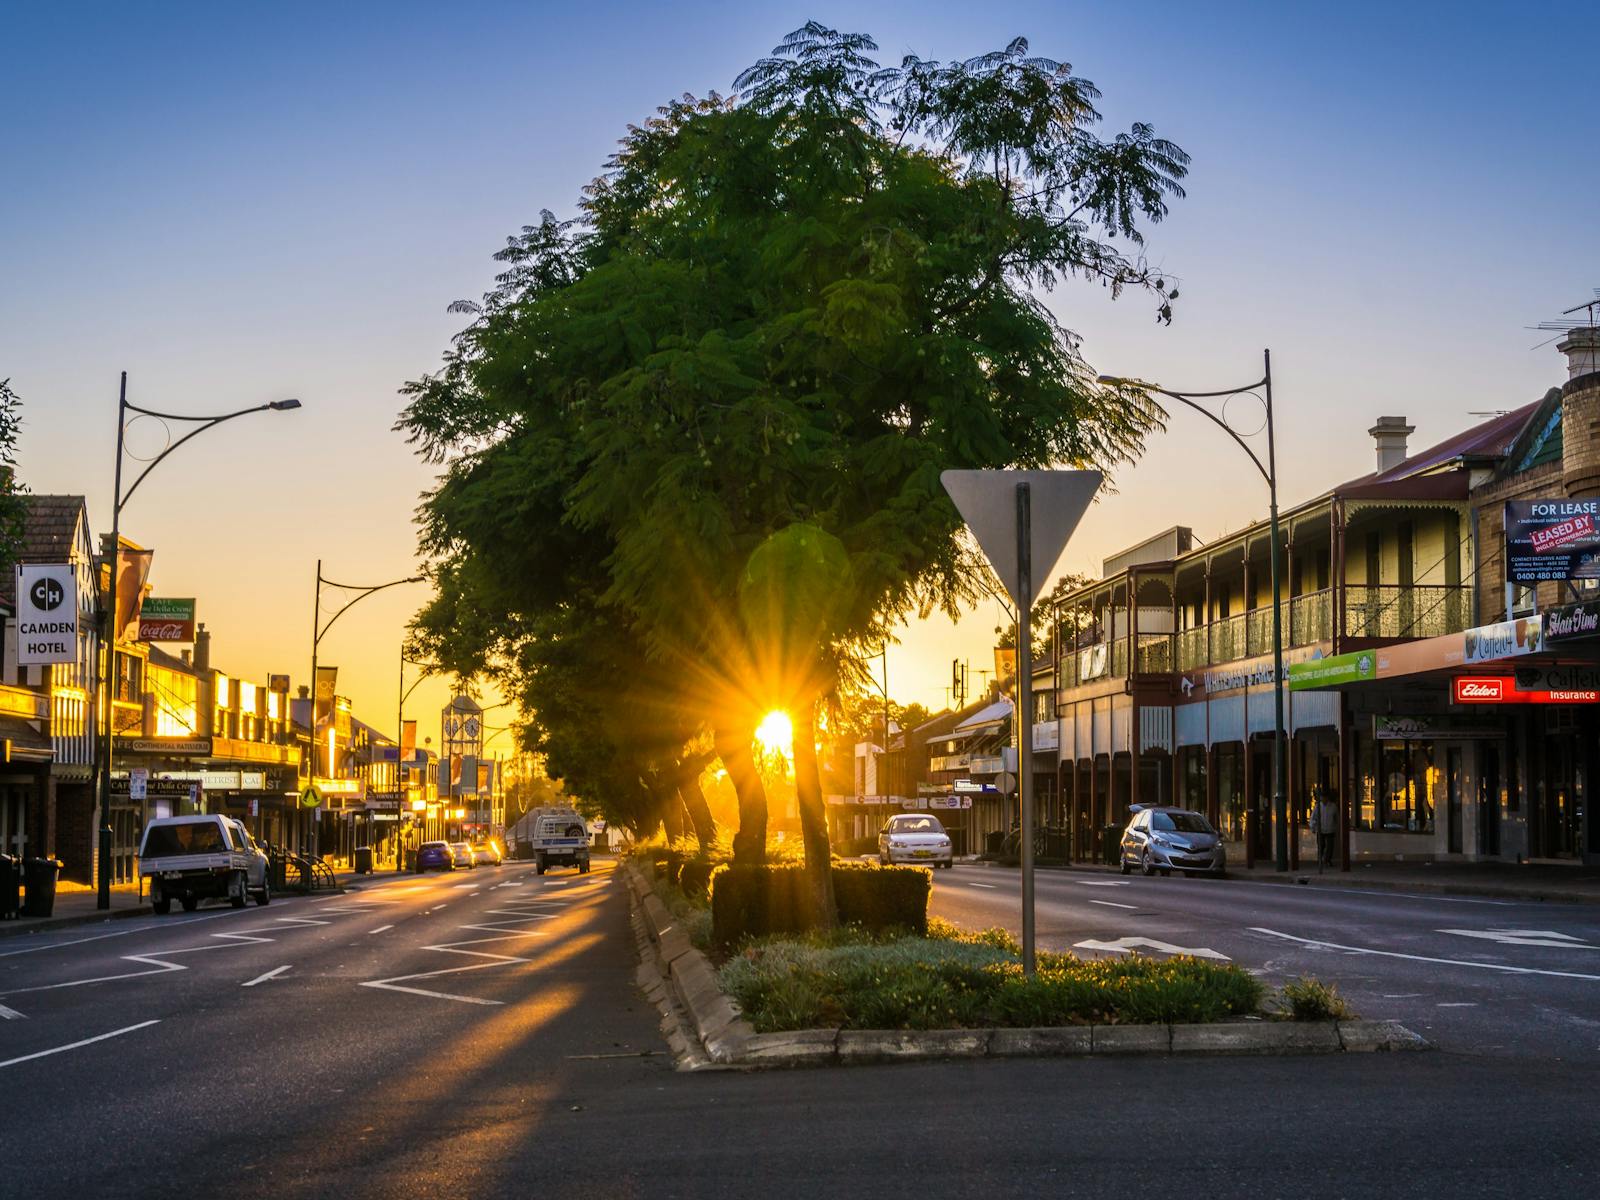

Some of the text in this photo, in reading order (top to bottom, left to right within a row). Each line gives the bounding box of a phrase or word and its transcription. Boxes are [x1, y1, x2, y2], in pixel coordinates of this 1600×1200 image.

[1532, 503, 1597, 516] FOR LEASE
[1532, 515, 1590, 545] LEASED BY
[1535, 541, 1555, 552] INGLIS
[1555, 527, 1592, 545] COMMERCIAL
[1516, 572, 1535, 580] 0400
[1536, 572, 1551, 580] 480
[1548, 606, 1598, 636] Hair Time
[20, 622, 75, 634] CAMDEN
[28, 642, 67, 654] HOTEL
[1462, 683, 1499, 697] Elders
[1550, 690, 1596, 700] Insurance
